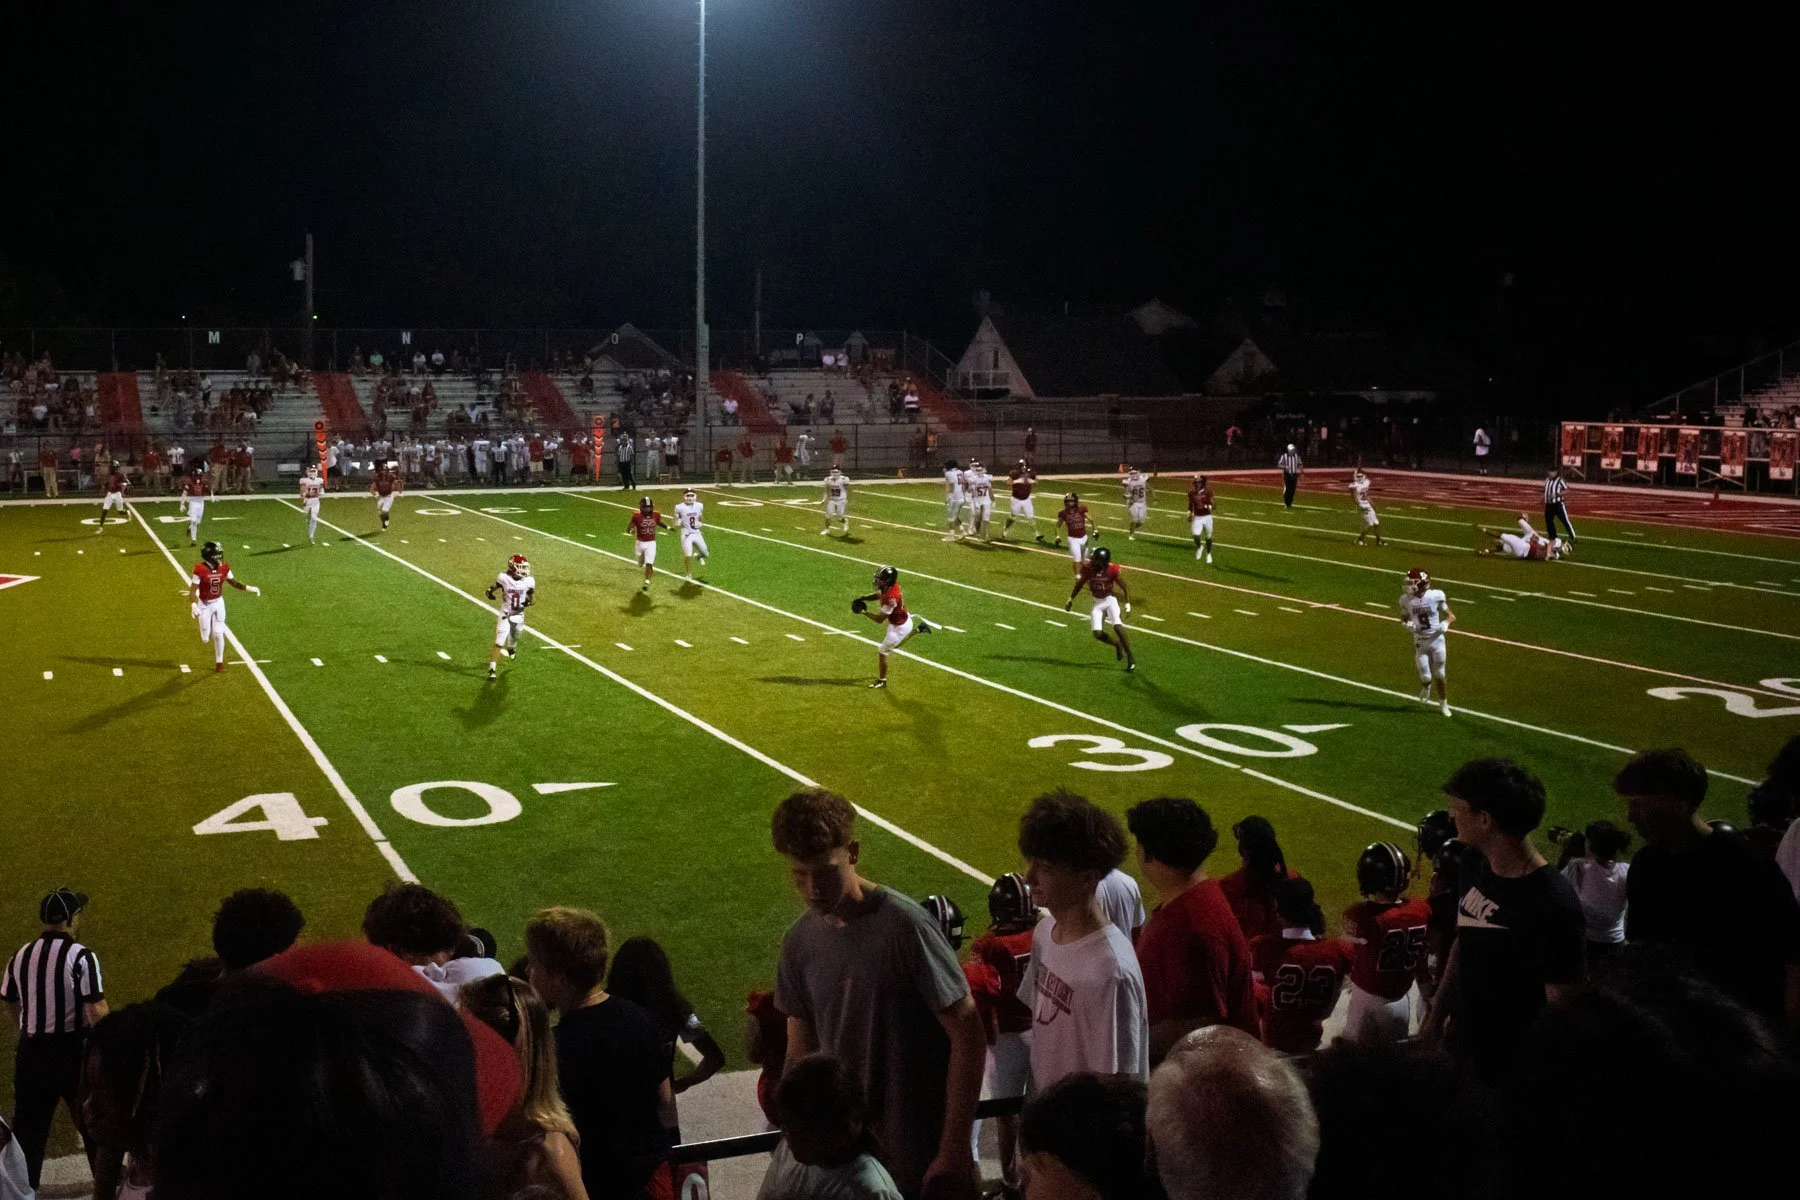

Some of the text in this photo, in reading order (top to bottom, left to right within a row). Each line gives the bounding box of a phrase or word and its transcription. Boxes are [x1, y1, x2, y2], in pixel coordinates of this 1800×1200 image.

[208, 330, 220, 345] M
[402, 331, 411, 345] N
[796, 332, 804, 345] P
[210, 577, 221, 595] 5
[511, 593, 520, 609] 0
[1418, 612, 1431, 631] 9
[1460, 886, 1501, 921] NIKE
[1376, 924, 1428, 972] 25
